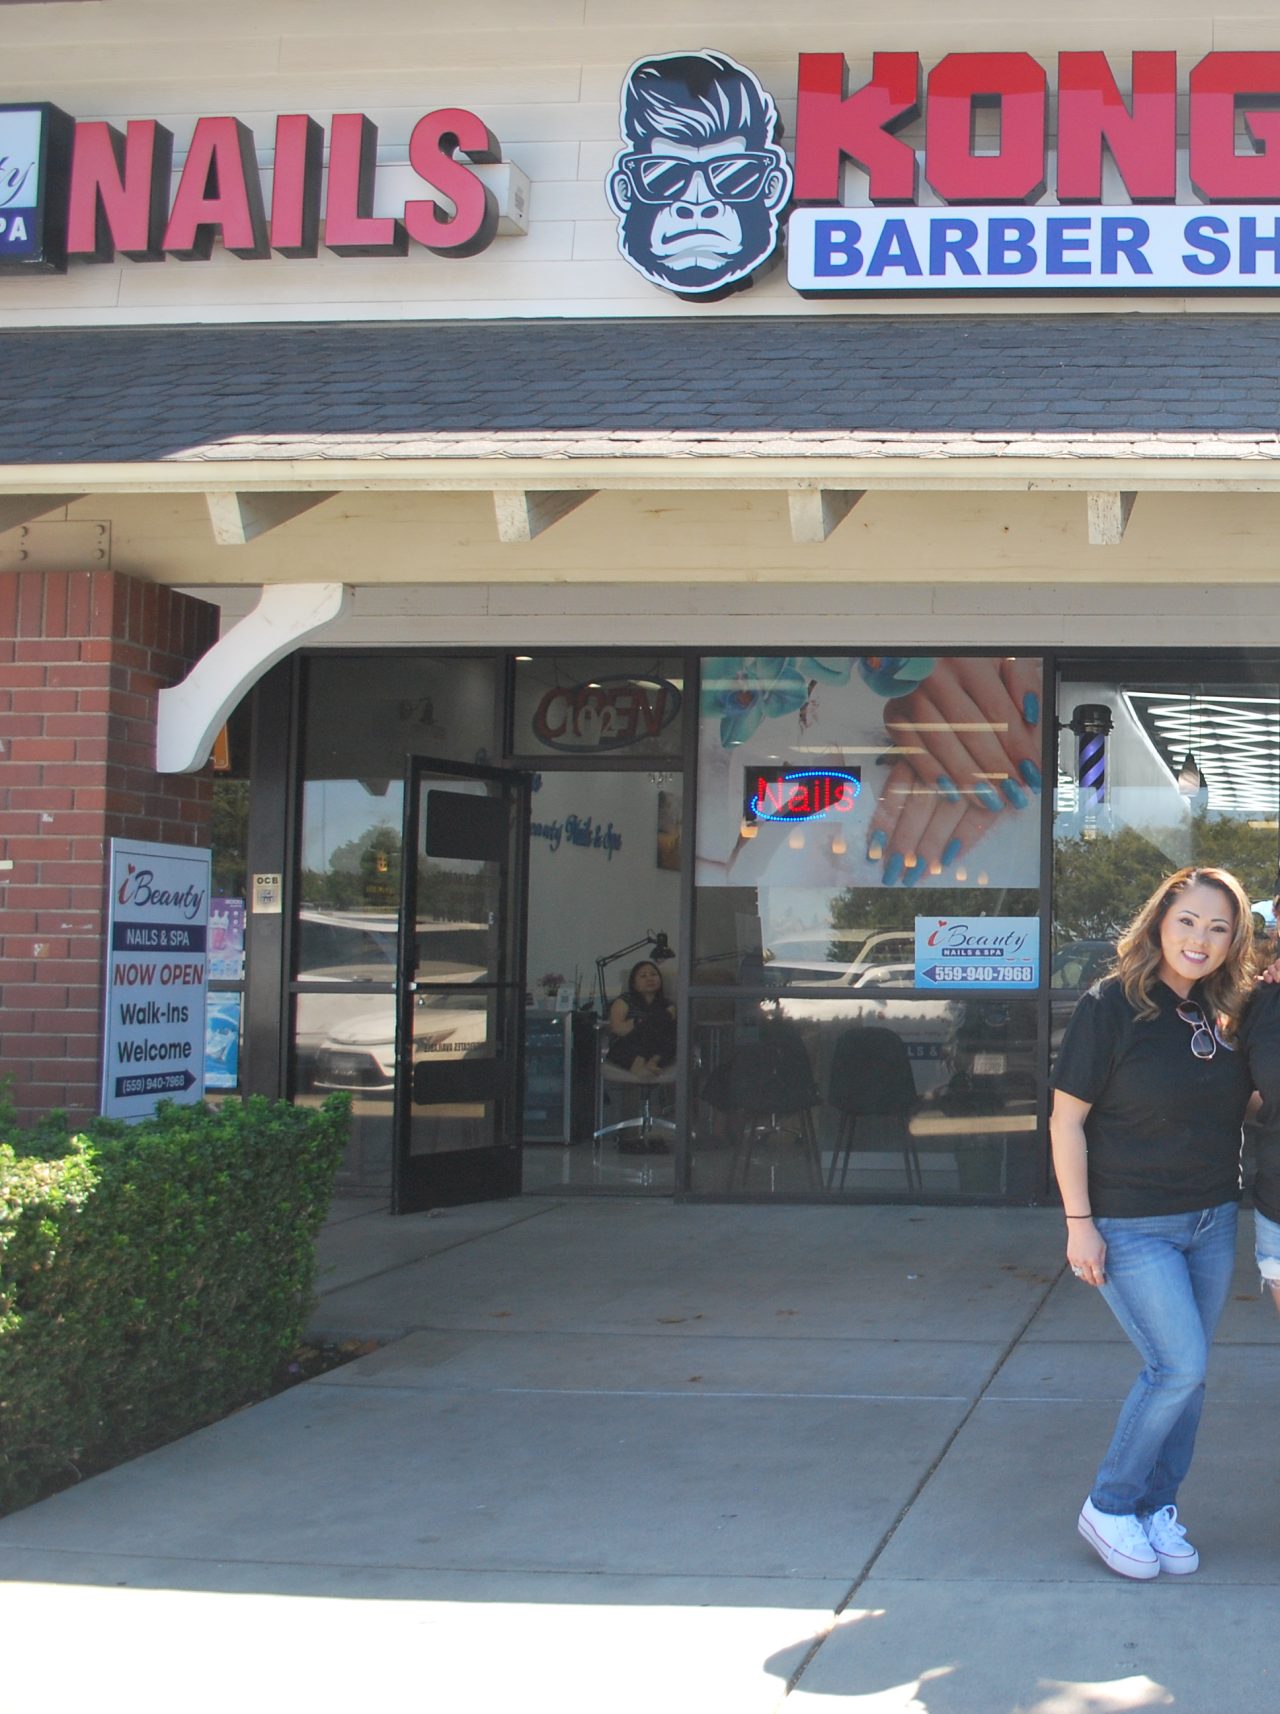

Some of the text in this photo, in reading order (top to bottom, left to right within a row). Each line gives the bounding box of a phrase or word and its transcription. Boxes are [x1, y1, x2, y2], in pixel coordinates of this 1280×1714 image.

[67, 108, 494, 255] NAILS
[812, 218, 1154, 277] BARBER
[757, 777, 854, 812] Nails
[257, 876, 279, 885] OCB
[127, 928, 190, 946] NAILS & SPA
[114, 963, 204, 986] NOW OPEN
[935, 966, 1031, 981] 559-940-7968
[120, 1001, 189, 1026] Walk-Ins
[117, 1040, 192, 1064] Welcome
[122, 1074, 185, 1094] (559) 940-7968
